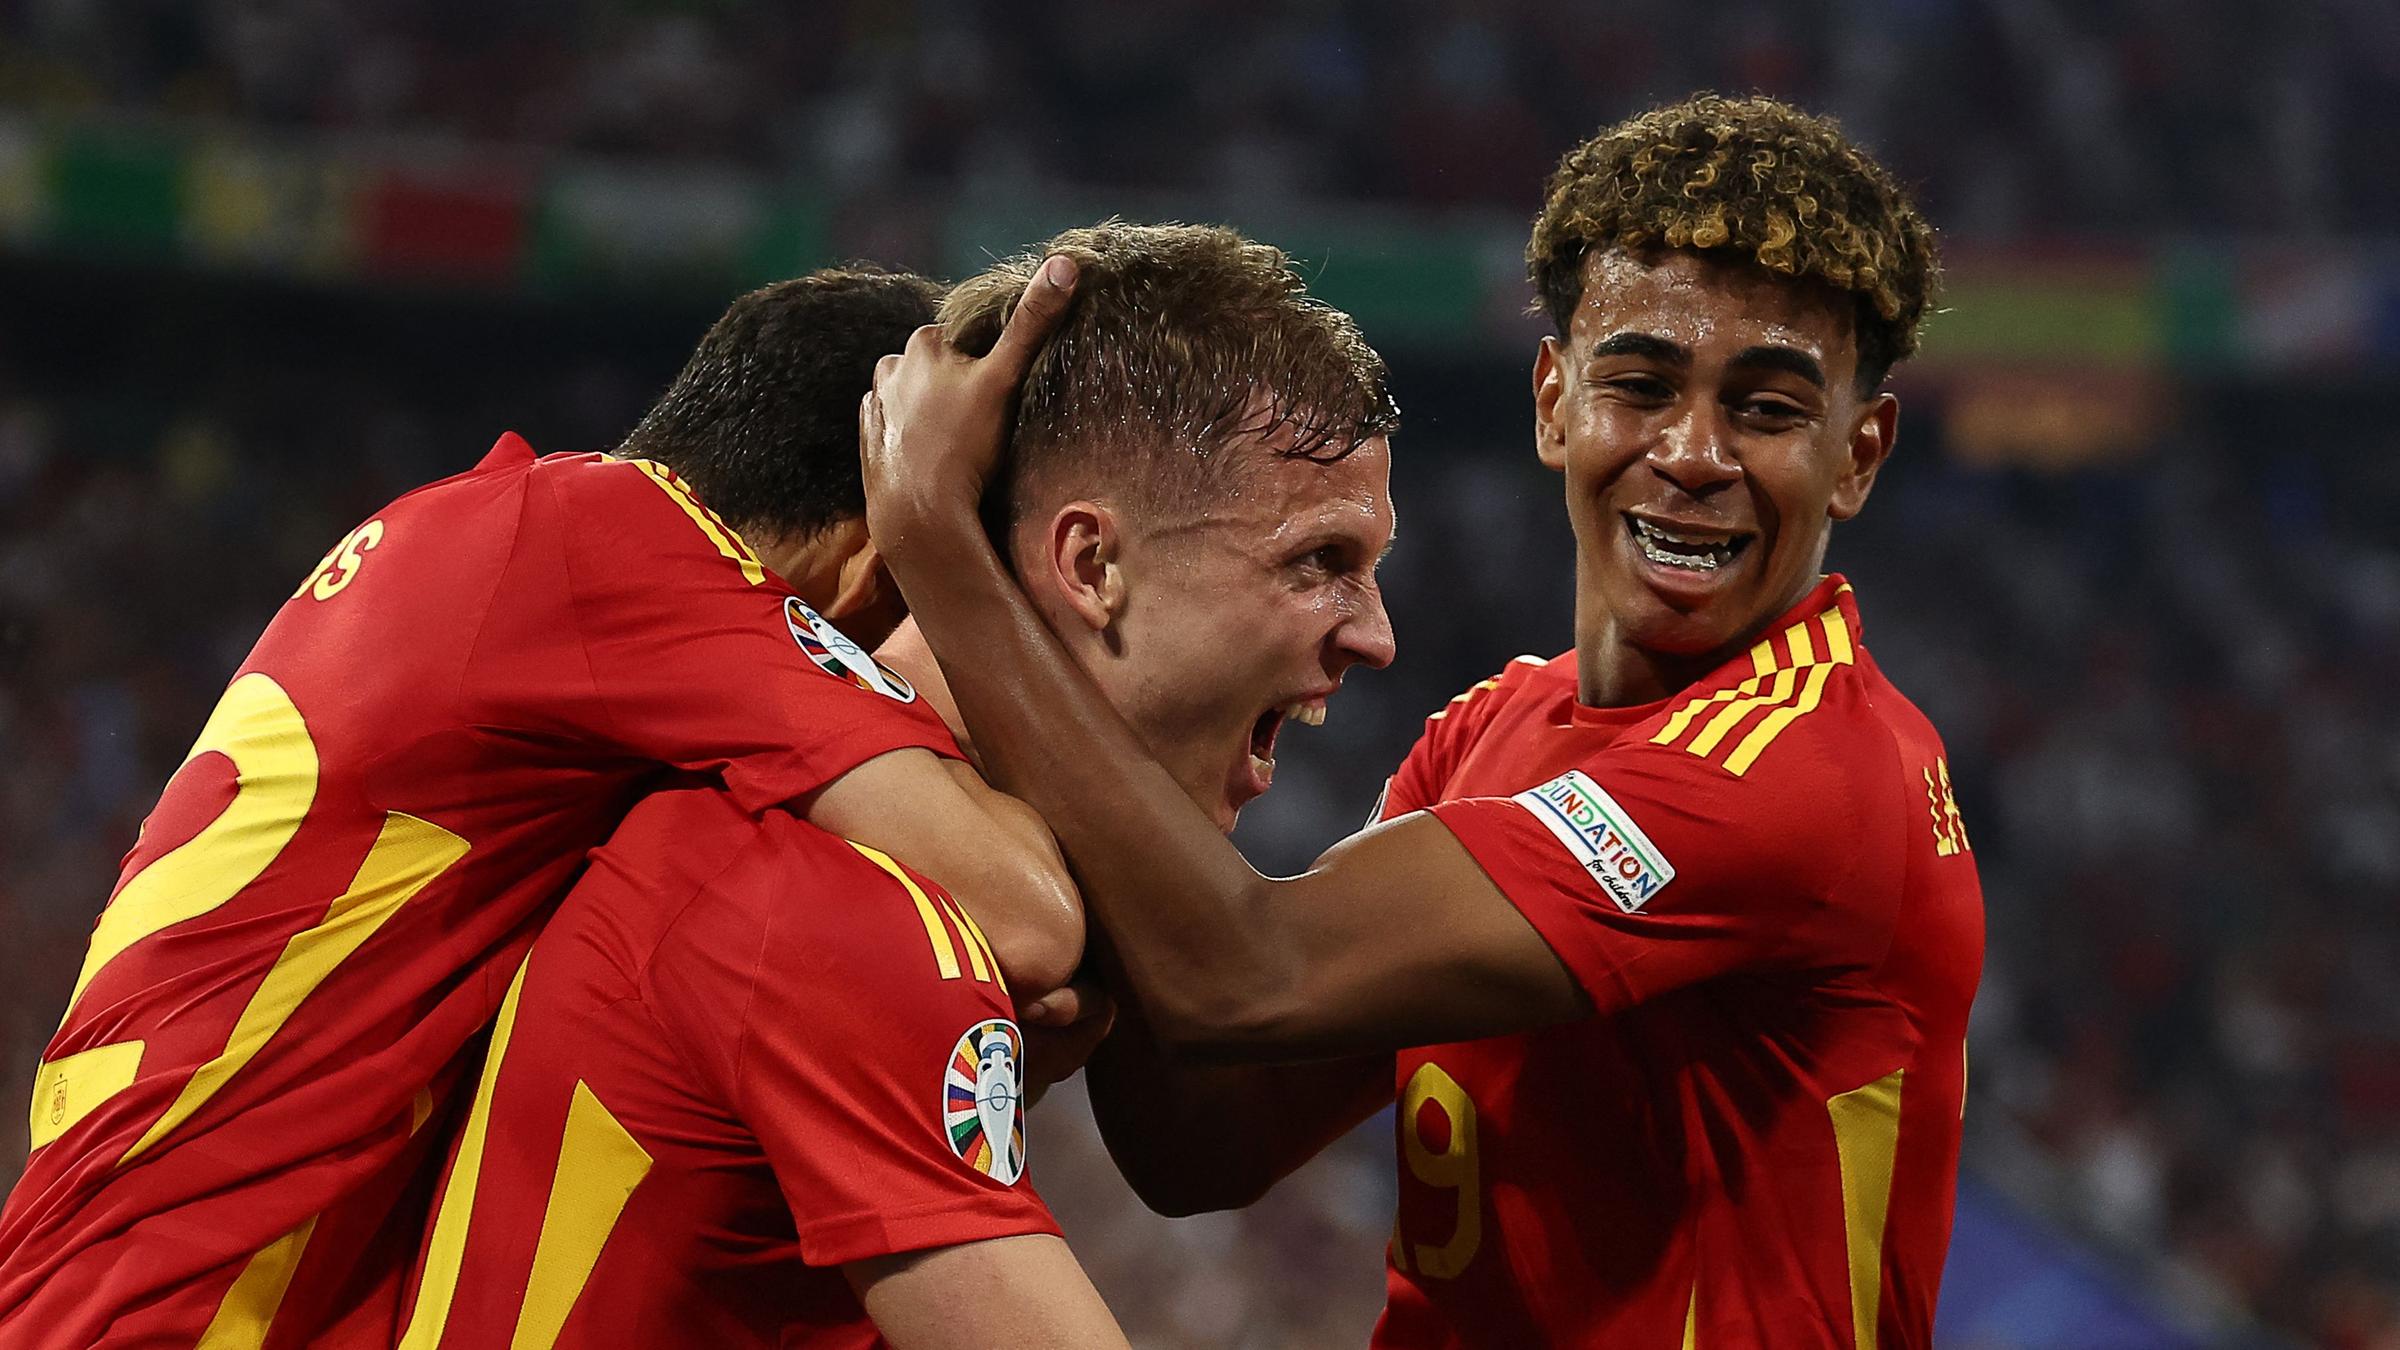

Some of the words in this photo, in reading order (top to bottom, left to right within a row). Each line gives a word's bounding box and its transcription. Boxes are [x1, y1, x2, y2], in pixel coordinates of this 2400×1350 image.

[30, 672, 320, 1152] 2
[1586, 858, 1605, 873] for
[1602, 872, 1634, 910] children
